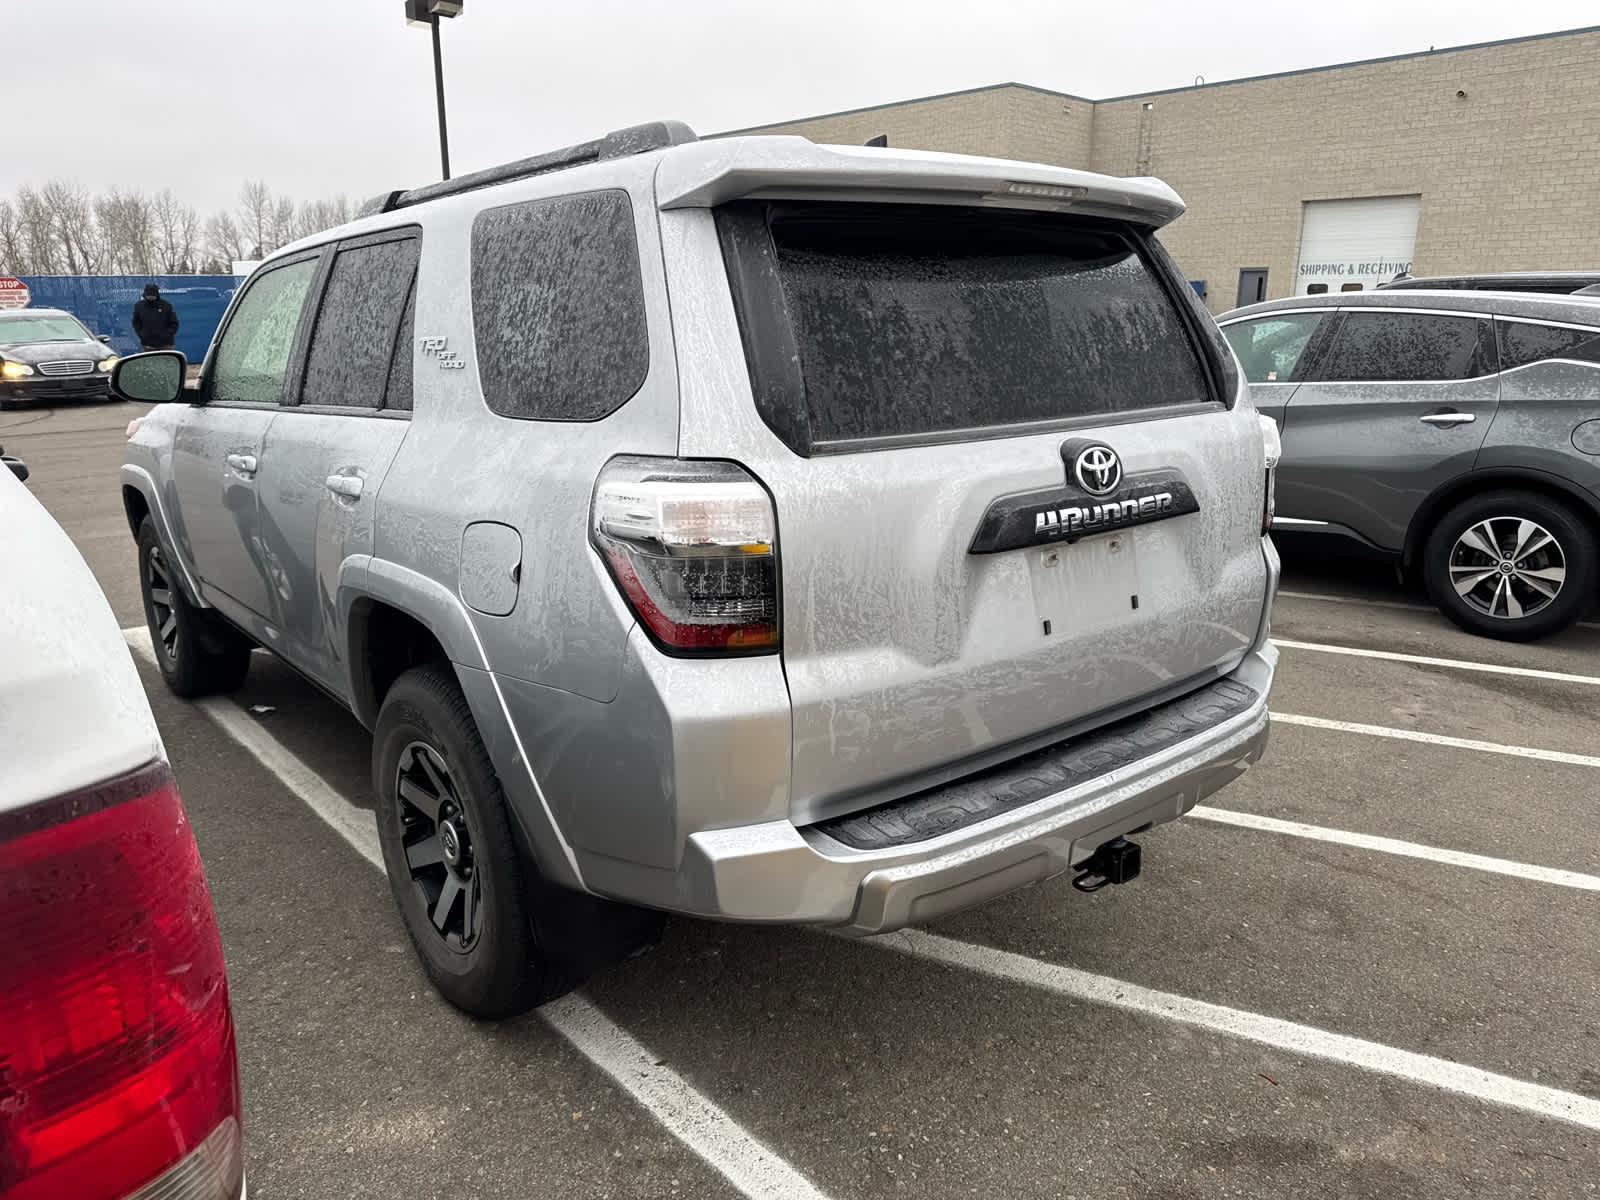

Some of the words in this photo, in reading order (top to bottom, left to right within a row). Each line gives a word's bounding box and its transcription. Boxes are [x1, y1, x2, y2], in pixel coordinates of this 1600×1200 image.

[1300, 263, 1345, 275] SHIPPING
[1347, 263, 1354, 275] &
[1358, 262, 1413, 275] RECEIVING
